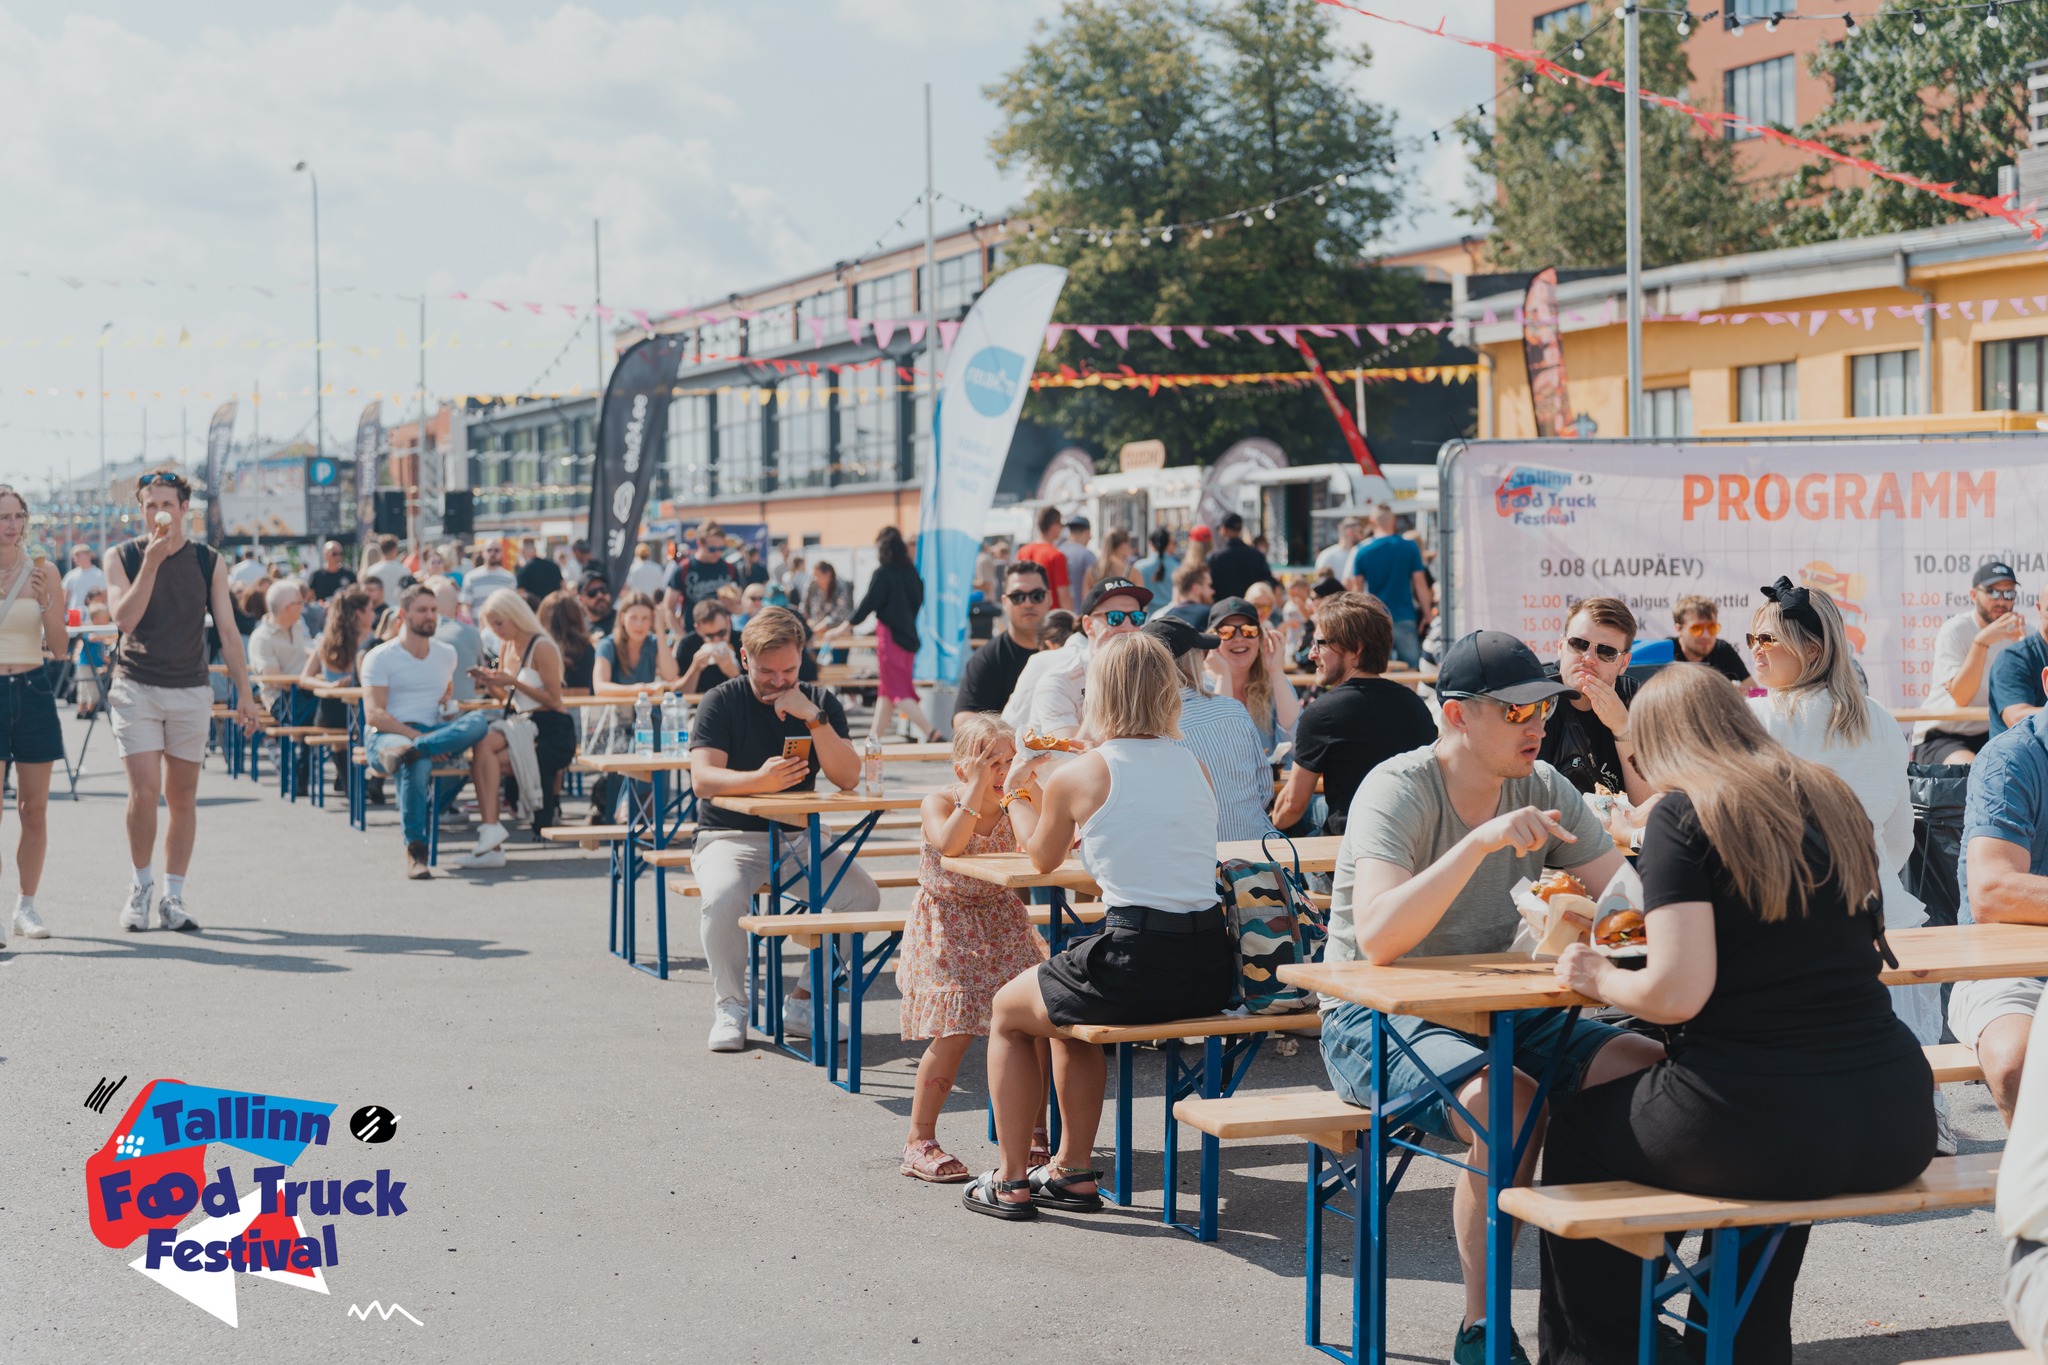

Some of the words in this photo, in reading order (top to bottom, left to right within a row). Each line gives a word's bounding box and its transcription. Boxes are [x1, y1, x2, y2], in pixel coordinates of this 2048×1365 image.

[1515, 470, 1572, 486] Tallinn
[1547, 492, 1597, 508] Truck
[1682, 471, 1997, 521] PROGRAMM
[1514, 510, 1576, 525] Festival
[1540, 558, 1586, 577] 9.08
[1592, 554, 1705, 579] (LAUPÄEV)
[1914, 554, 1972, 574] 10.08
[1522, 594, 1562, 609] 12.00
[1901, 592, 1941, 606] 12.00
[1522, 617, 1563, 631] 15.00
[1901, 615, 1943, 629] 14.00
[1901, 661, 1933, 675] 15.0
[1901, 684, 1930, 697] 16.0
